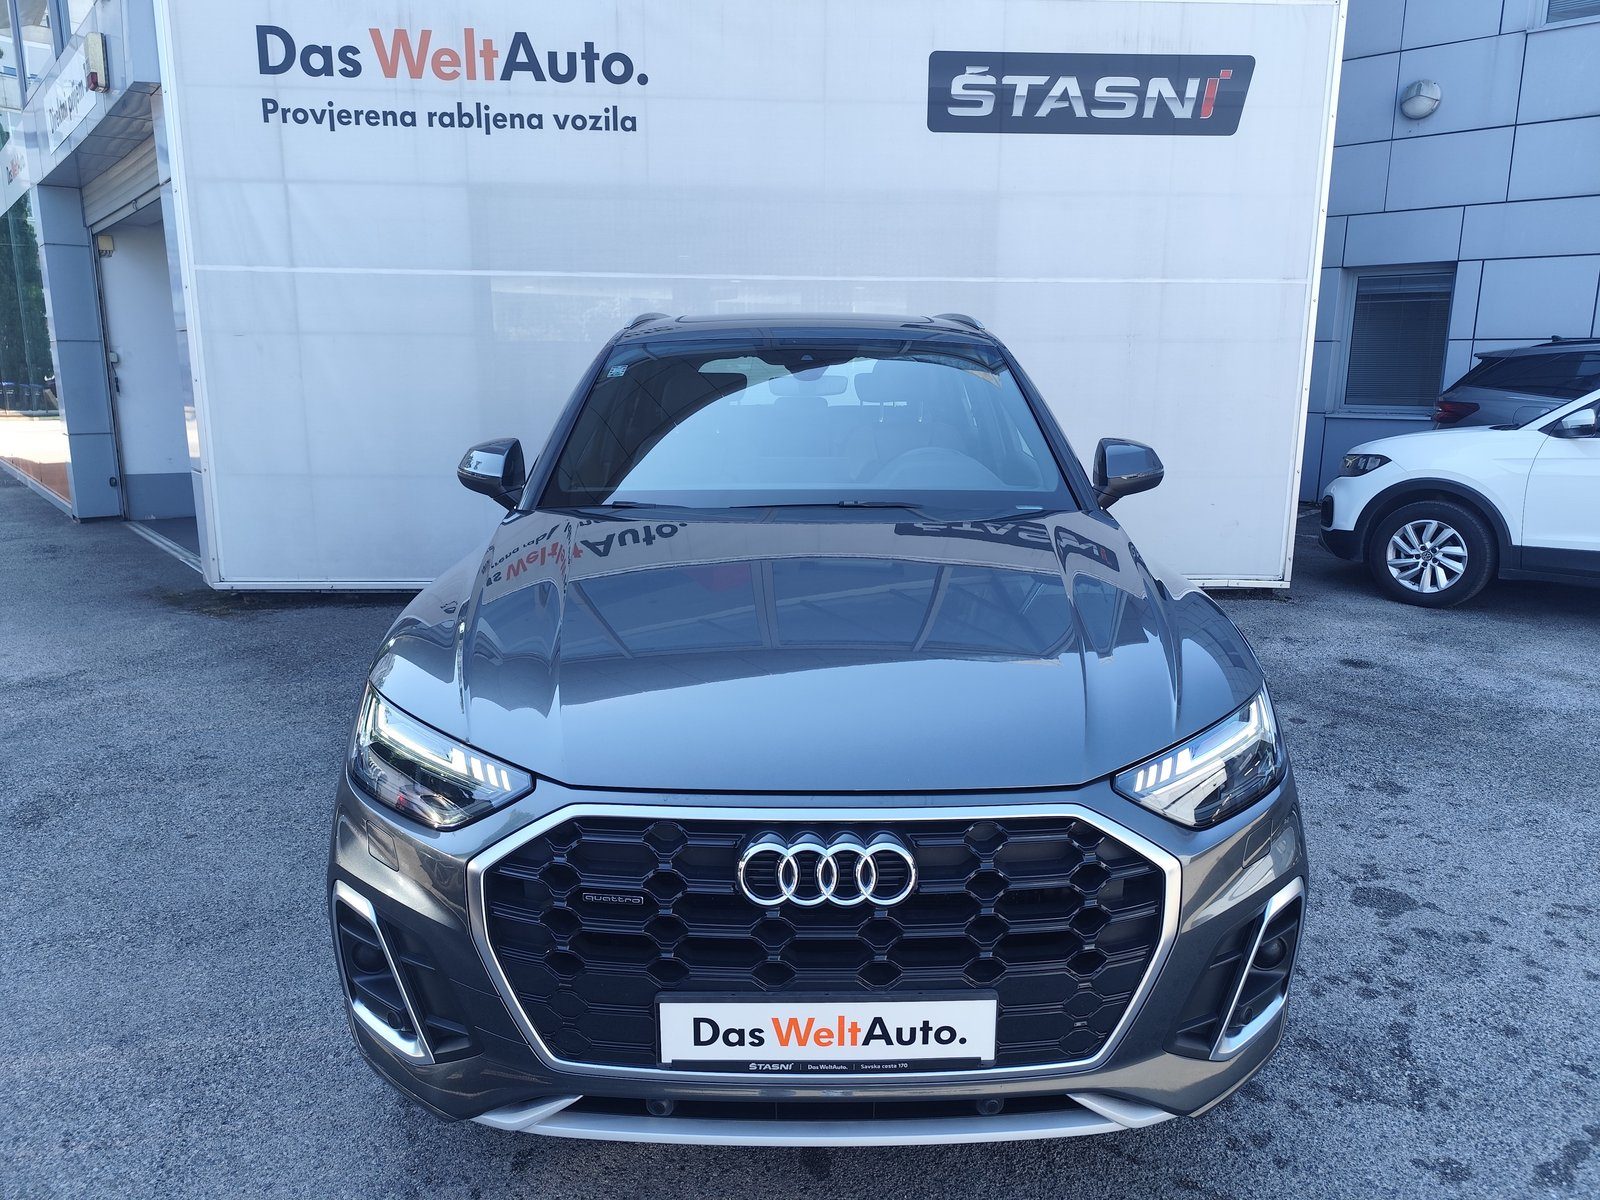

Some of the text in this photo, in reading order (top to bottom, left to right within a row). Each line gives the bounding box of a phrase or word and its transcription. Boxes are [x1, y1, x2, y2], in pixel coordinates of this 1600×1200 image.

[256, 25, 649, 86] Das WeltAuto.
[261, 98, 637, 135] Provjerena rabljena vozila
[585, 895, 641, 904] quattro
[692, 1015, 968, 1047] Das WeltAuto.
